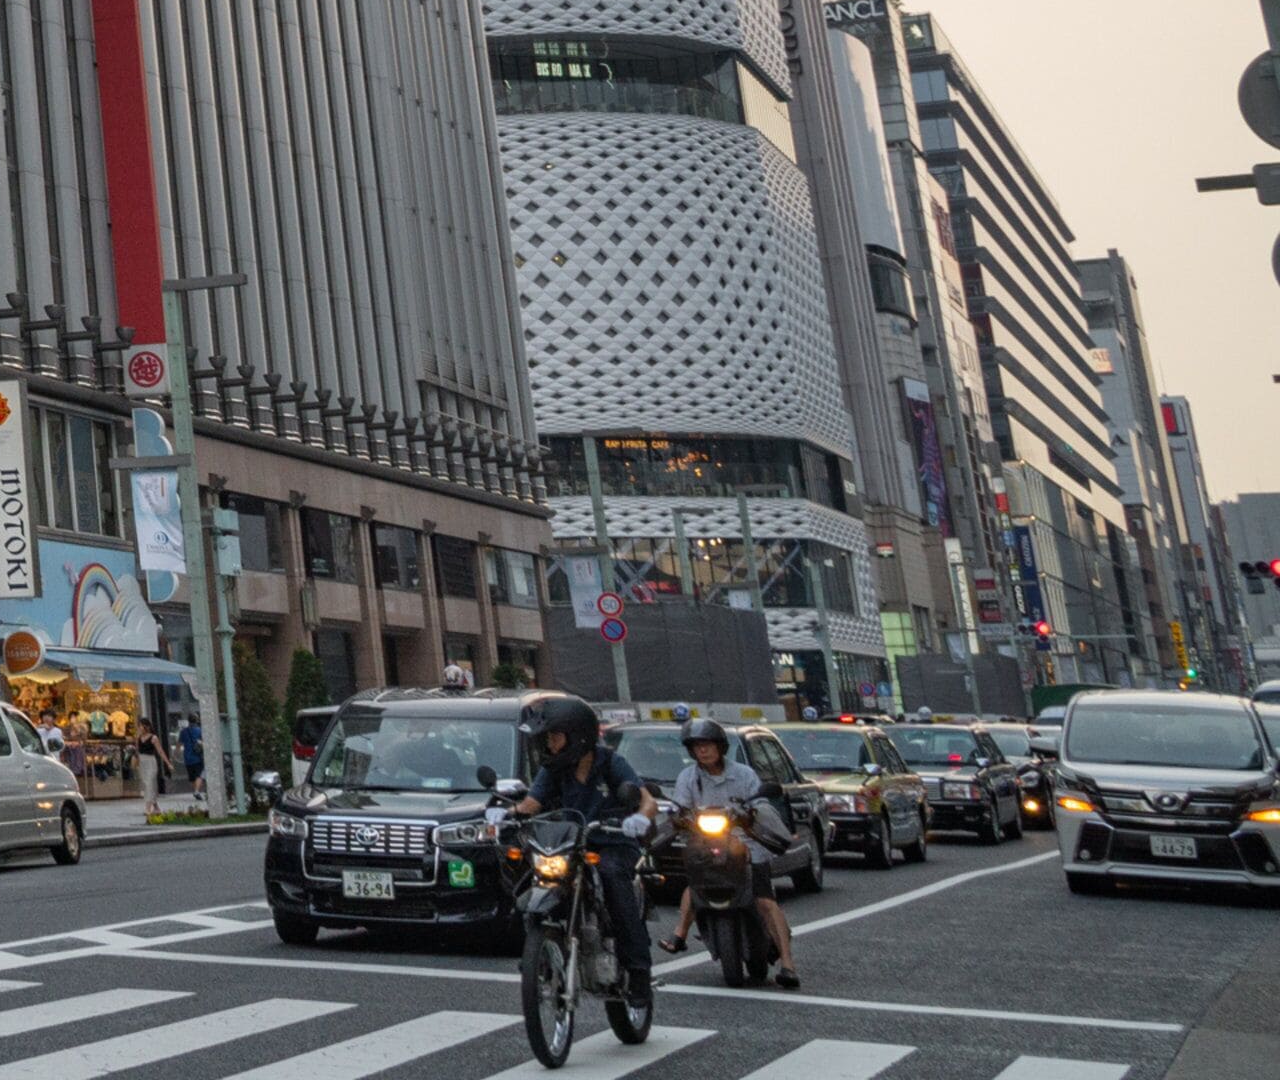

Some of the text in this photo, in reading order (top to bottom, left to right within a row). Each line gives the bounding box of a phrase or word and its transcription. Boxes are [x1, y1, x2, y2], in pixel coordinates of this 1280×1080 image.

[824, 0, 885, 22] ANCL
[0, 467, 28, 591] MOTOKI
[603, 599, 617, 610] 50
[354, 882, 392, 897] 36-94
